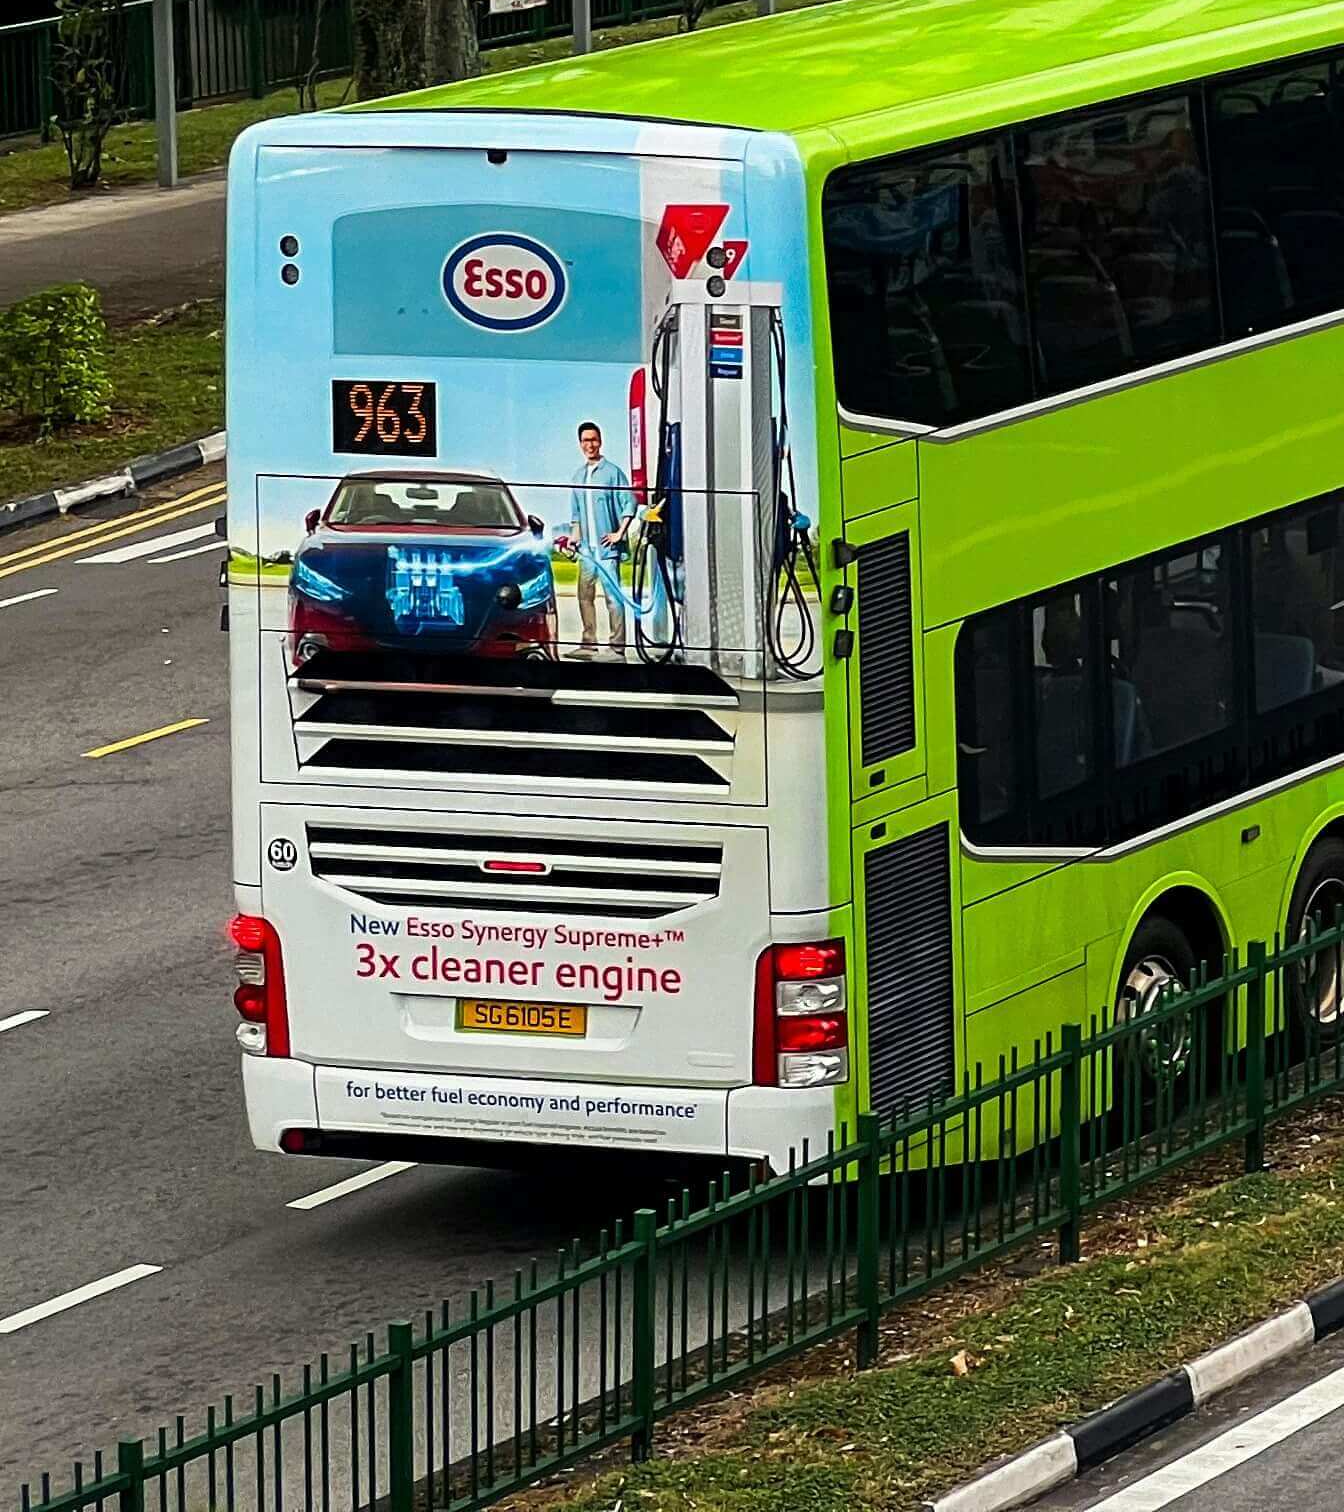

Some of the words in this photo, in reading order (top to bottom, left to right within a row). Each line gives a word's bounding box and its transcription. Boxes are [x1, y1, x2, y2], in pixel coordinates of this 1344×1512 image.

[463, 258, 548, 301] Esso
[348, 384, 427, 443] 963
[270, 840, 295, 861] 60
[350, 913, 400, 936] New
[406, 916, 455, 938] Esso
[461, 919, 548, 950] Synergy
[355, 943, 401, 979] 3x
[411, 944, 545, 986] cleaner
[555, 956, 681, 1001] engine
[474, 1003, 572, 1029] SG6105E
[346, 1080, 371, 1098] for
[375, 1082, 427, 1102] better
[431, 1086, 463, 1104] fuel
[467, 1091, 545, 1114] economy
[549, 1095, 581, 1112] and
